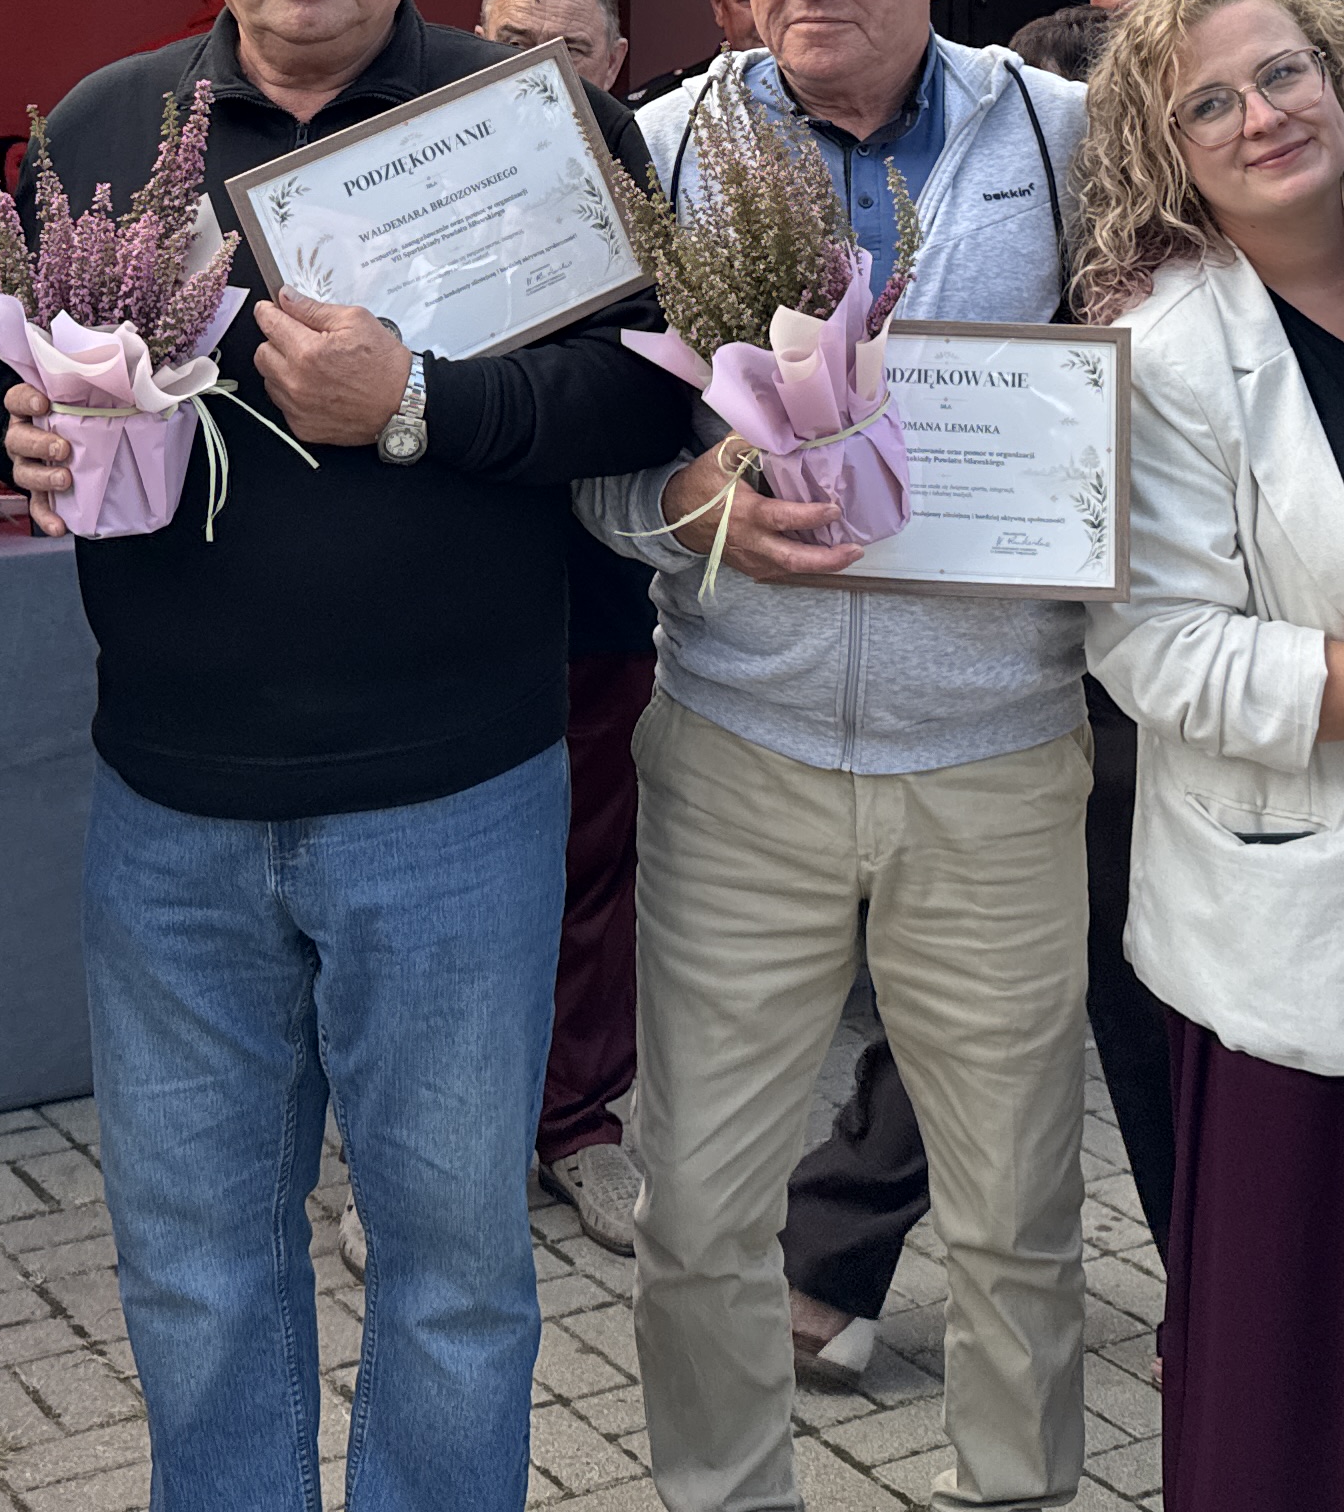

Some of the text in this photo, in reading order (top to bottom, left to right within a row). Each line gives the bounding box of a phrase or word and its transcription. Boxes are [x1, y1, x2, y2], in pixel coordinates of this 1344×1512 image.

[342, 118, 496, 197] PODZIĘKOWANIE
[357, 165, 518, 243] WALDEMARA BRZOZOWSKIEGO
[901, 420, 942, 432] OMANA
